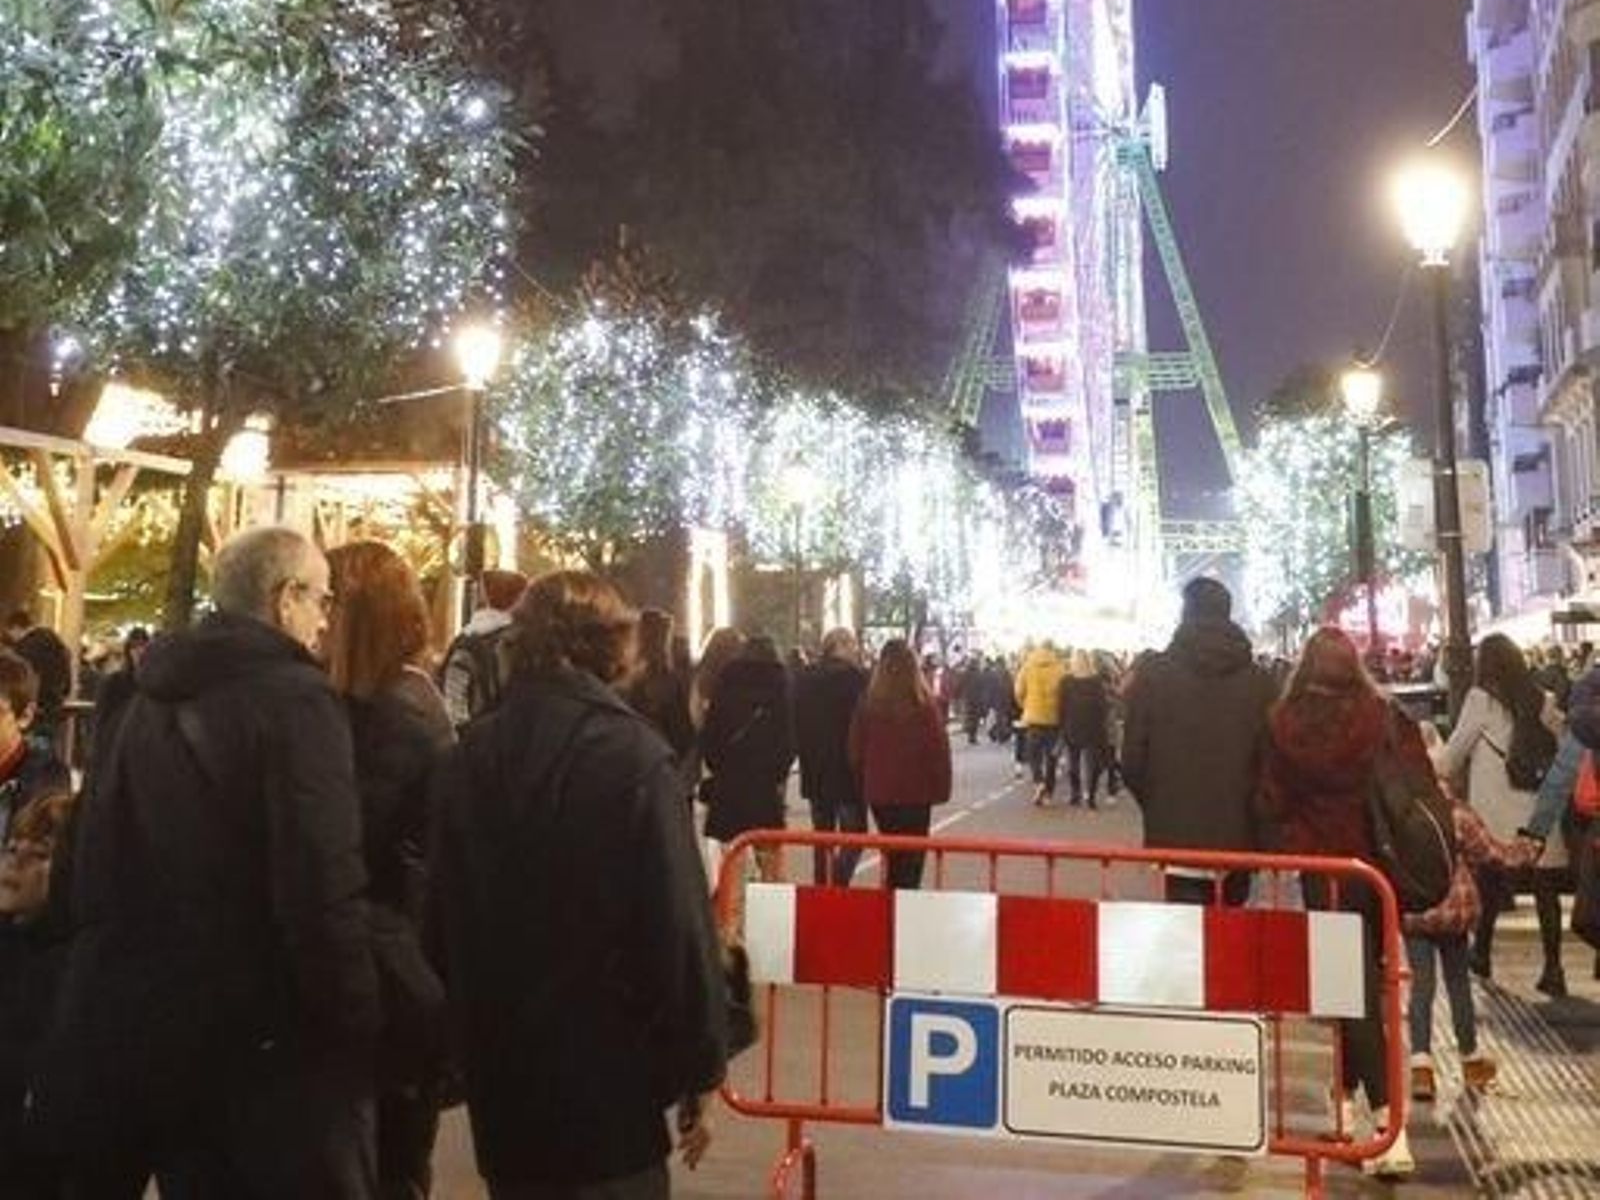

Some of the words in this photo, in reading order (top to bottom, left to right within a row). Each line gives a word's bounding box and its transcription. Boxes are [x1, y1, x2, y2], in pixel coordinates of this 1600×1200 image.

[910, 1014, 978, 1108] P
[1014, 1044, 1108, 1066] PERMITIDO
[1113, 1051, 1177, 1070] ACCESO
[1182, 1056, 1257, 1075] PARKING
[1049, 1080, 1100, 1099] PLAZA
[1105, 1086, 1220, 1108] COMPOSTELA
